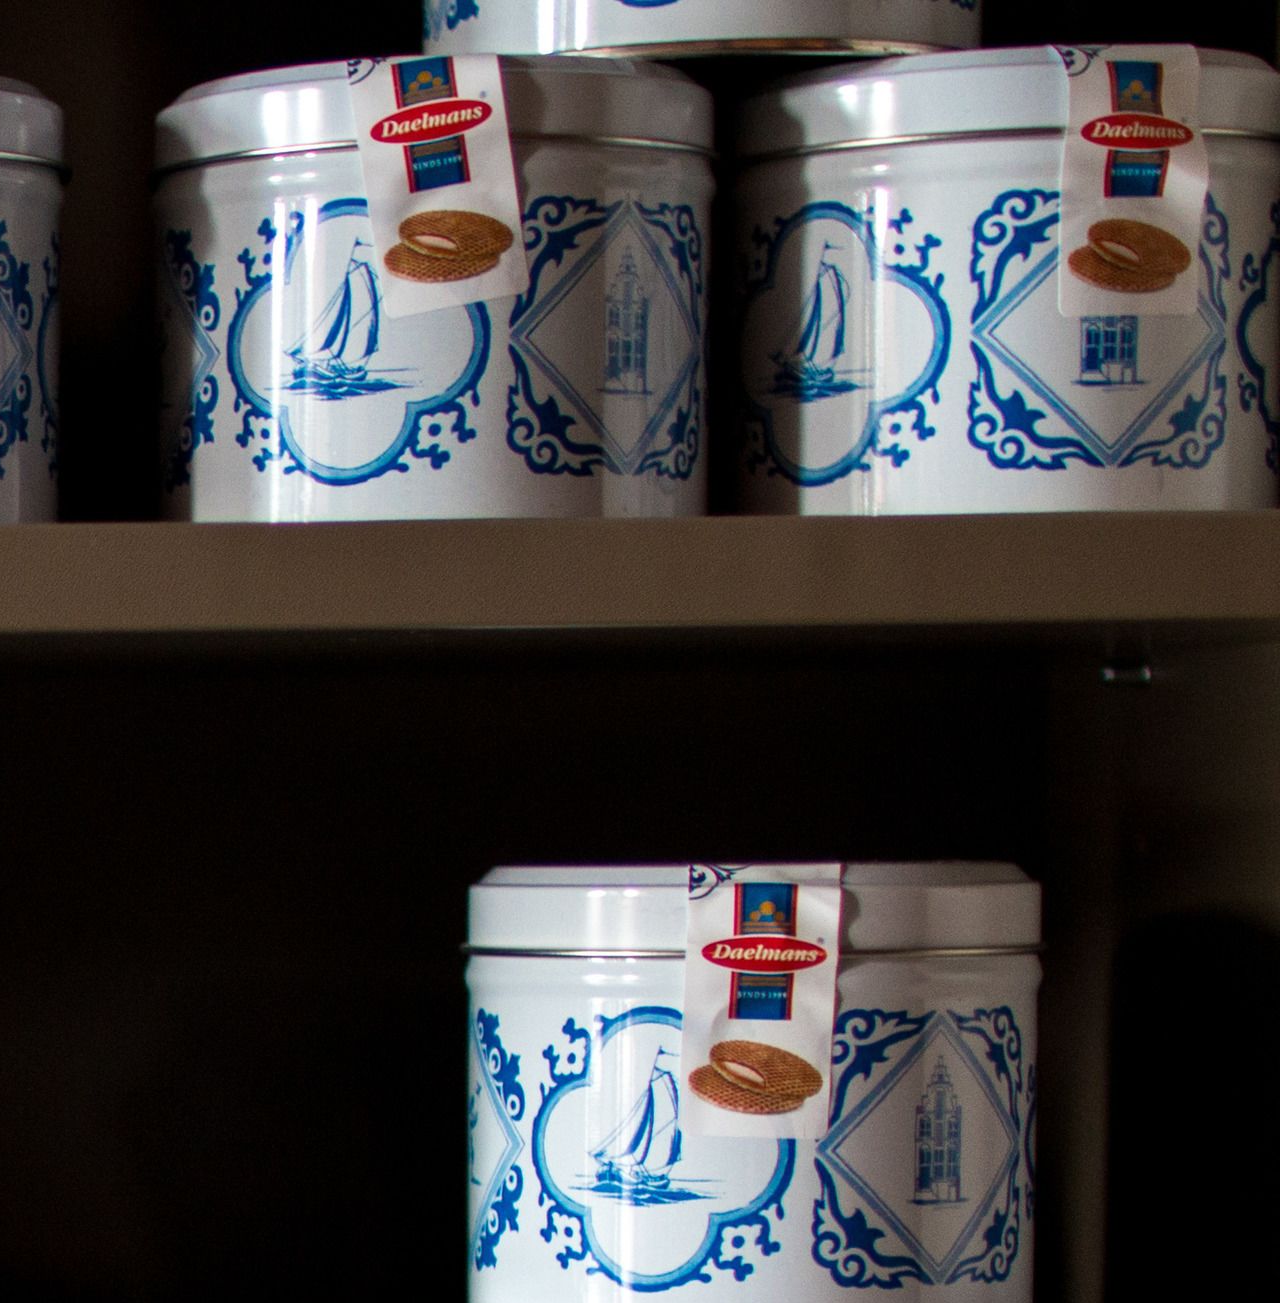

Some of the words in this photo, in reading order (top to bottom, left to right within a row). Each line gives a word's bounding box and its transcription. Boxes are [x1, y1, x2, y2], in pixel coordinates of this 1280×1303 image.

[381, 106, 483, 138] Daelmans
[1092, 122, 1186, 138] Daelmans
[713, 944, 817, 962] Daelmans
